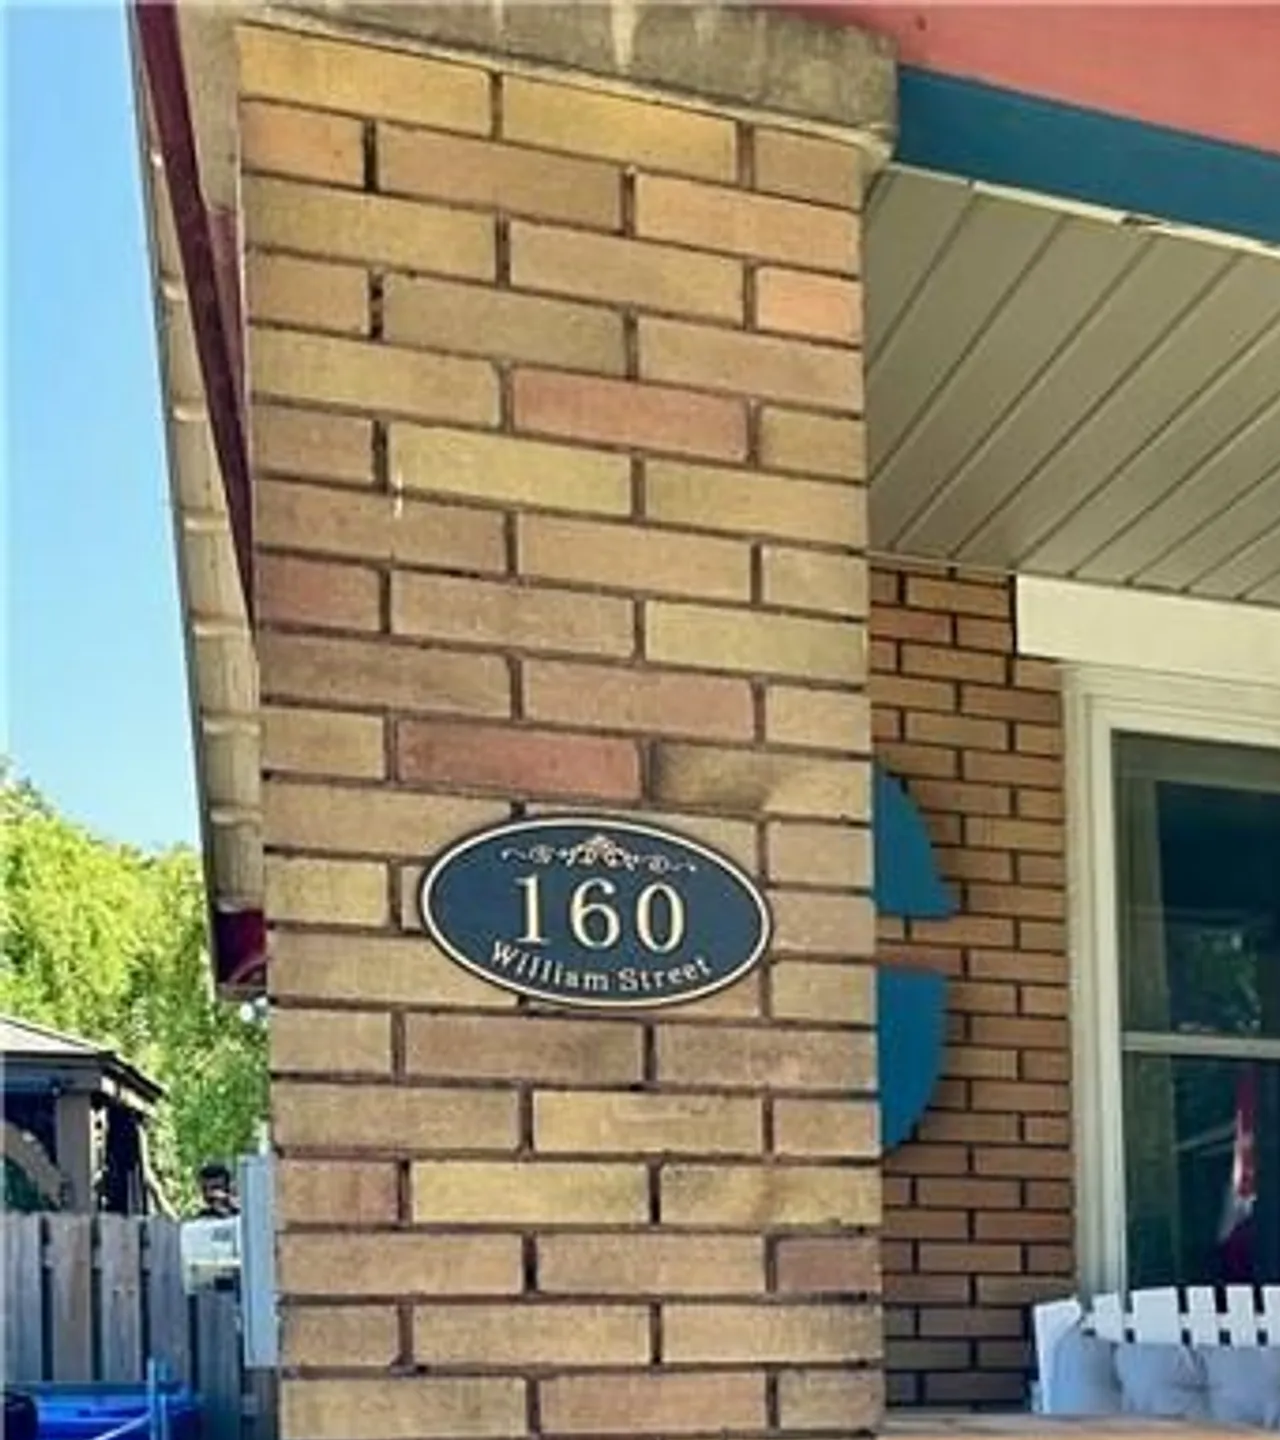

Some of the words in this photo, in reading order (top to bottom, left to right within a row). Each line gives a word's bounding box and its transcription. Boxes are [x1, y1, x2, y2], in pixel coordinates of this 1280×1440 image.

[514, 873, 684, 954] 160
[491, 940, 610, 992] William
[618, 957, 713, 992] Street
